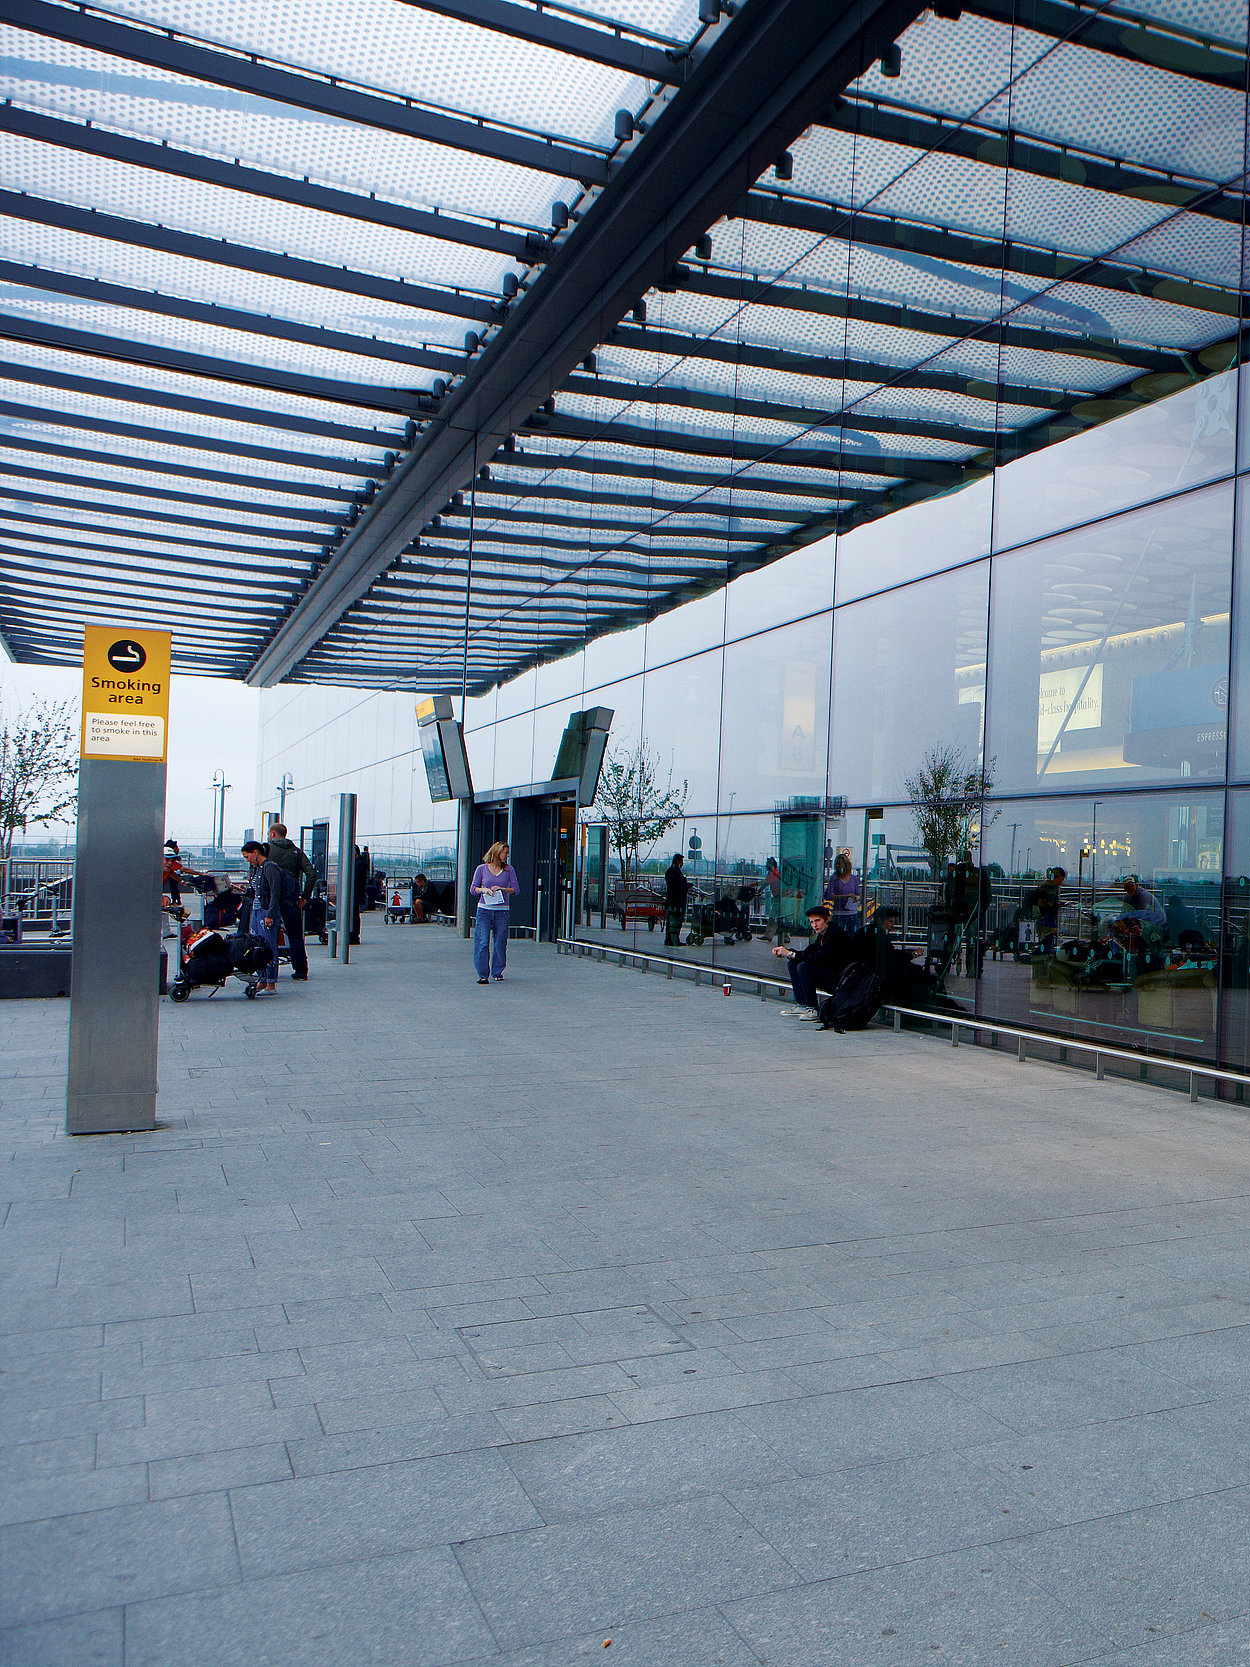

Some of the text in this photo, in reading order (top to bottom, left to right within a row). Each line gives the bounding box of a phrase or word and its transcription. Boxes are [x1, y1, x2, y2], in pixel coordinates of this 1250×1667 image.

[91, 676, 161, 695] Smoking
[1059, 685, 1066, 696] to
[108, 693, 144, 705] area
[1063, 696, 1099, 714] hpitality.
[91, 717, 155, 728] Please feel free
[91, 726, 101, 734] to
[102, 727, 131, 735] smoke
[142, 728, 158, 737] this
